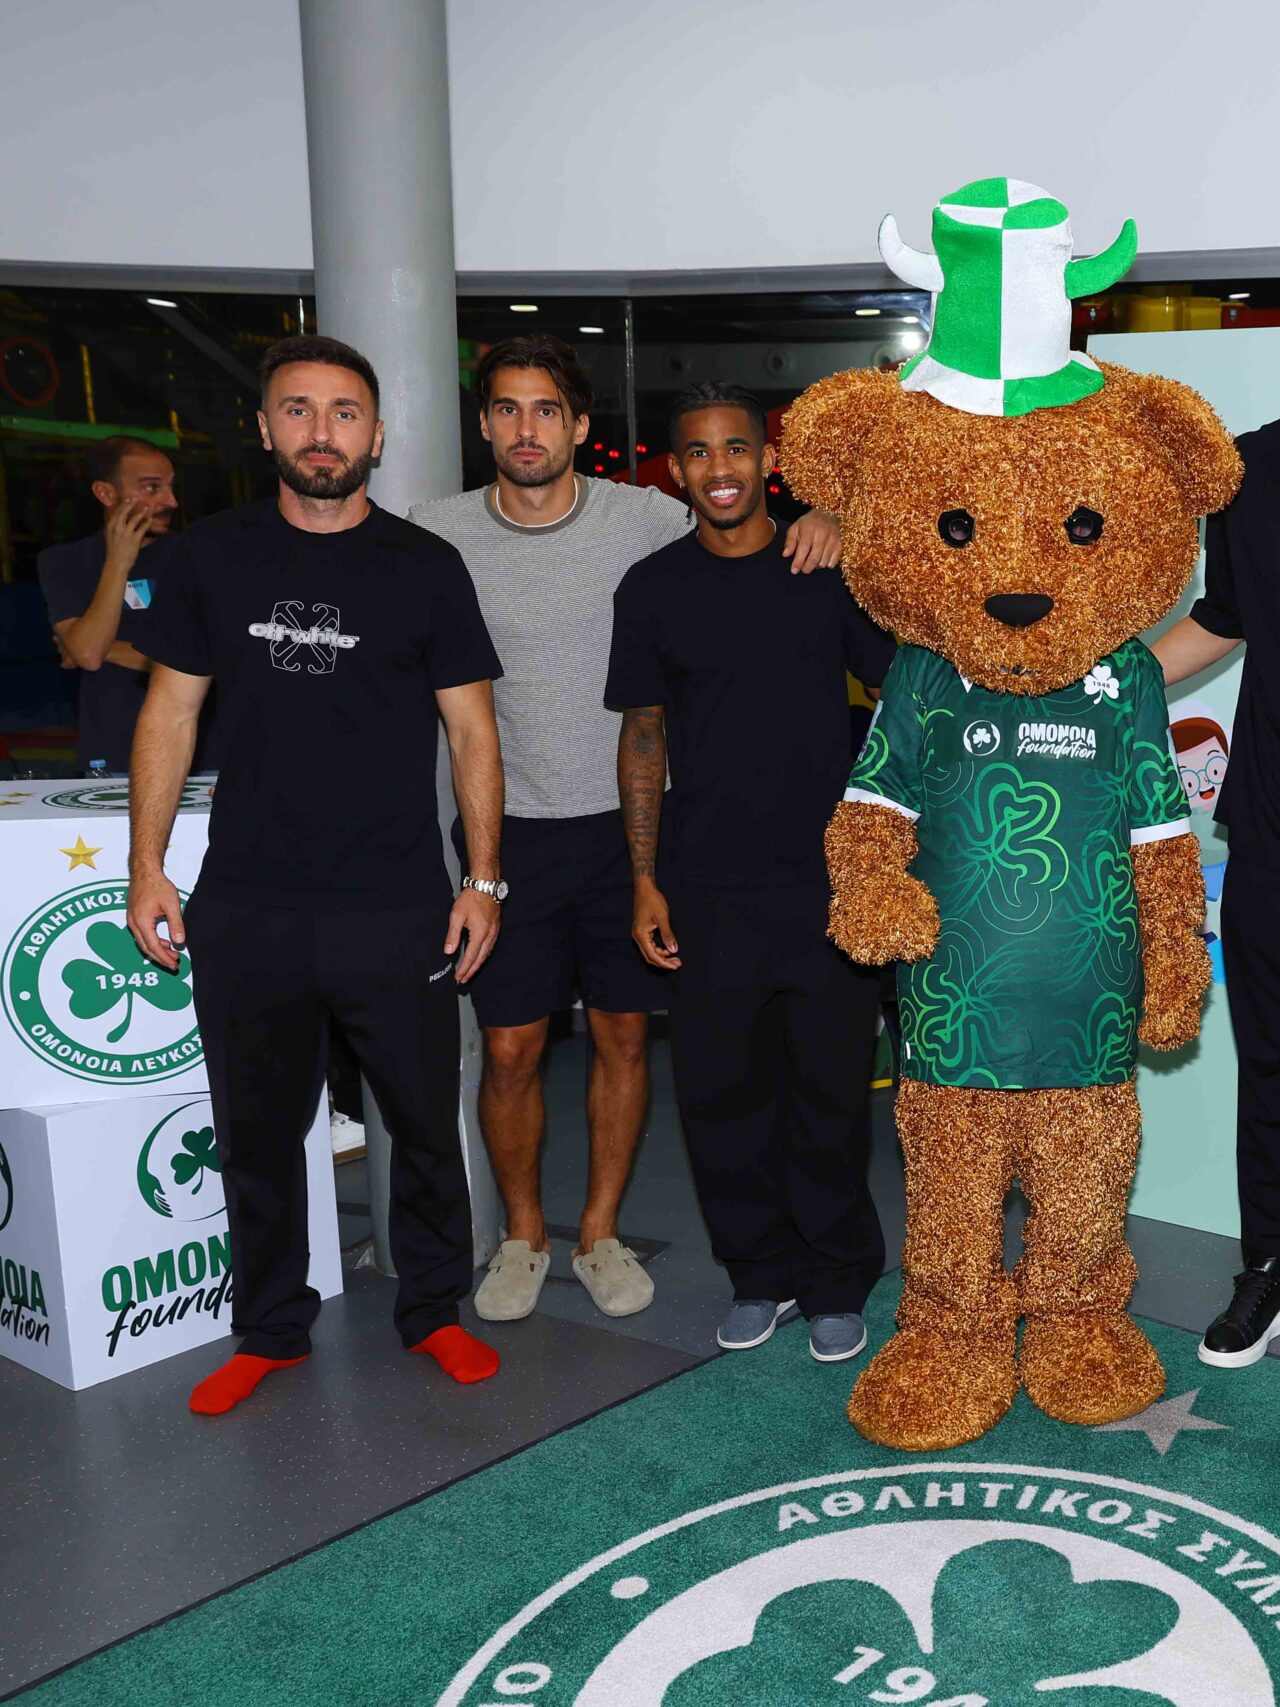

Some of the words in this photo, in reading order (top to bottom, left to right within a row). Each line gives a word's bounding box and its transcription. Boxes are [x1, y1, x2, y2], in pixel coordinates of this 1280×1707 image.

[1017, 737, 1096, 760] foundation
[1019, 723, 1096, 748] OMONOIA
[23, 891, 126, 957] ΑΘΛΗΤΙΚΟΣ
[96, 972, 159, 989] 1948
[31, 1024, 123, 1073] ΟΜΟΝΟΙΑ
[131, 1033, 203, 1072] ΛΕΥΚΩΣ
[102, 1231, 232, 1312] OMON
[778, 1482, 1177, 1540] ΑΘΛΗΤΙΚΟΣ
[832, 1646, 990, 1707] 19
